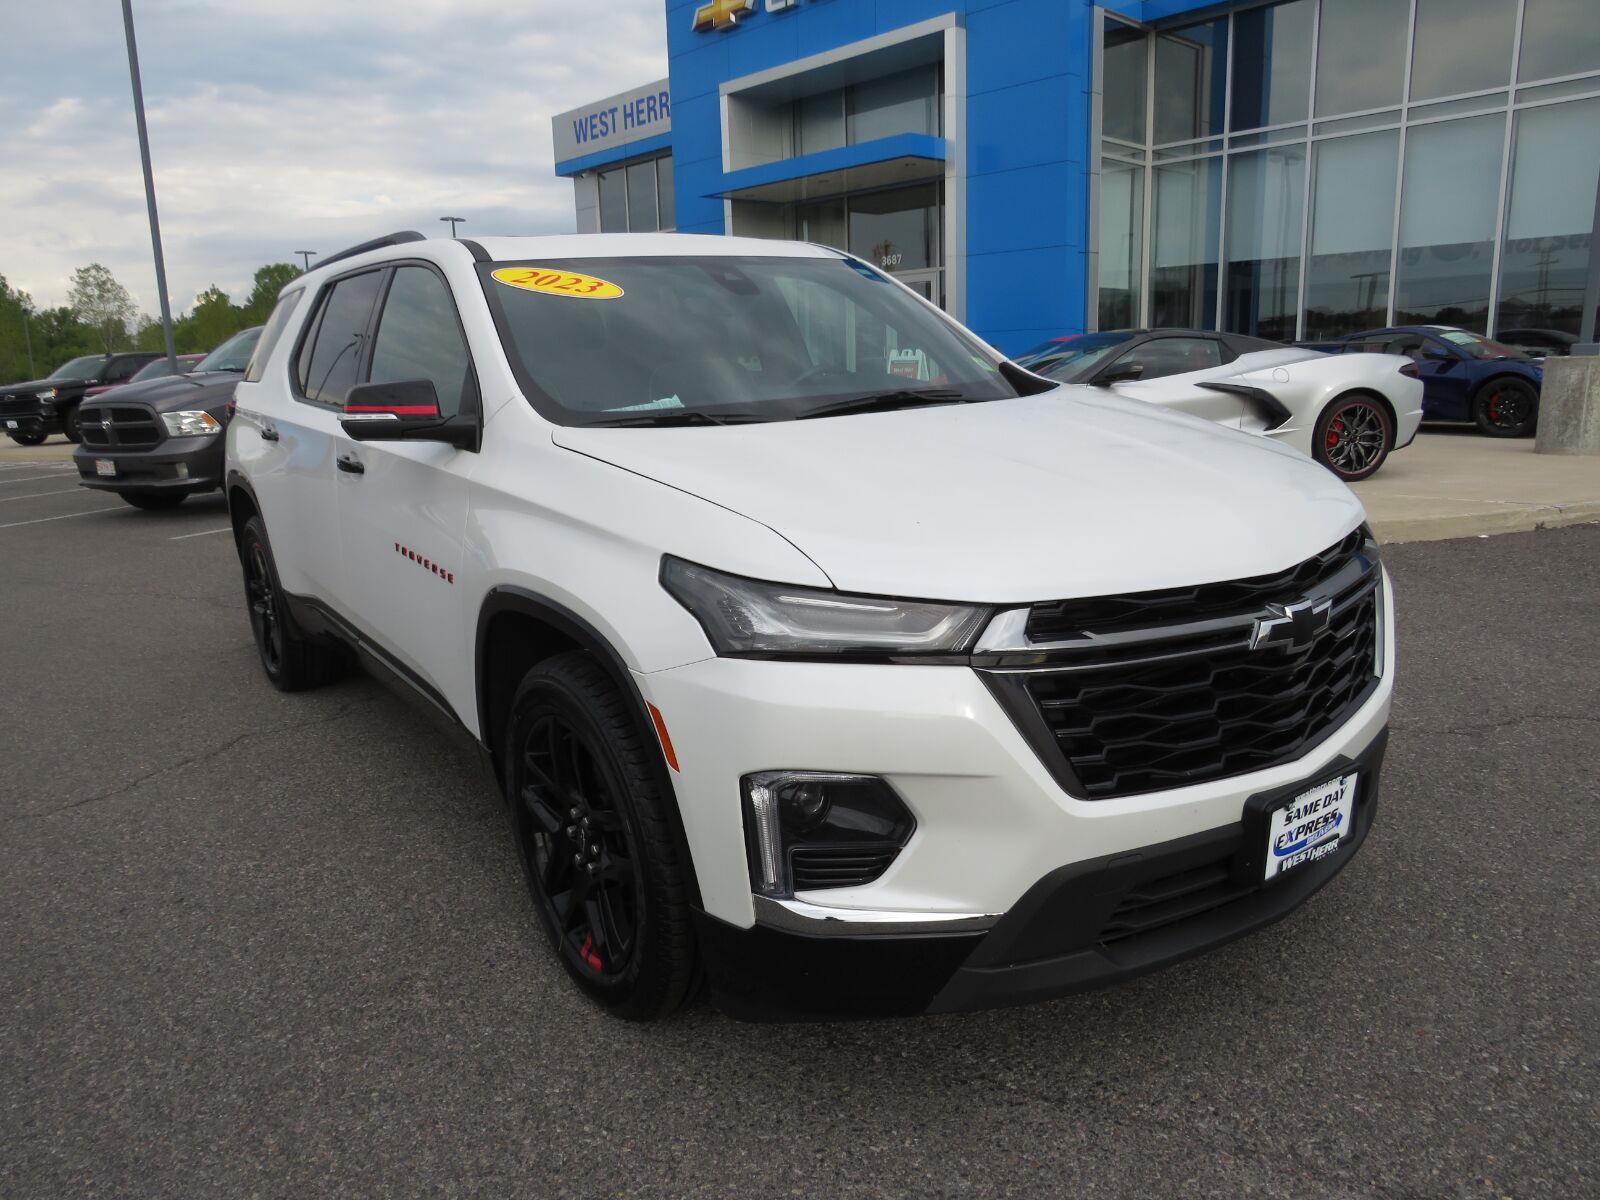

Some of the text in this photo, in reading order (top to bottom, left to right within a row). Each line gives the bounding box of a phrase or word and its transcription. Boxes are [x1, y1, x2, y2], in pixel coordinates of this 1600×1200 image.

[573, 91, 671, 145] WEST HERR
[881, 253, 902, 266] 3687
[511, 271, 604, 293] 2023
[394, 542, 454, 584] TRAVERSE
[1284, 785, 1348, 827] SAME DAY
[1277, 807, 1339, 849] EXPRESS
